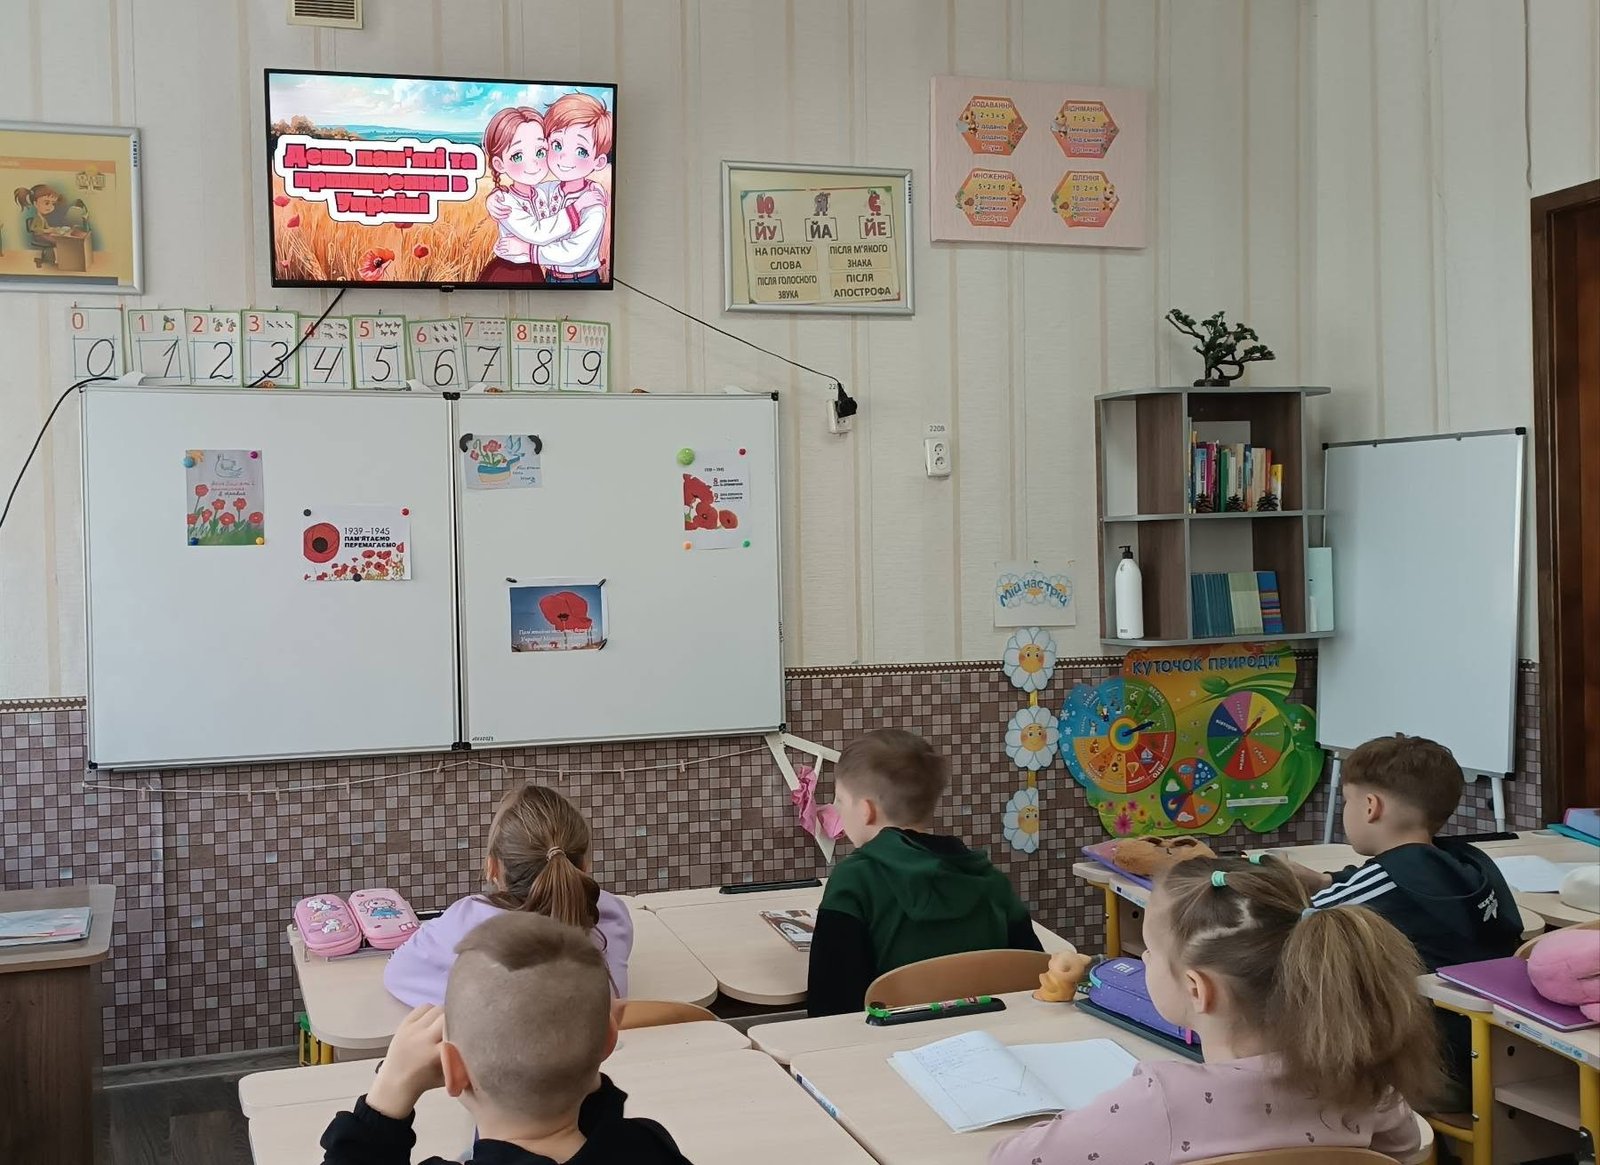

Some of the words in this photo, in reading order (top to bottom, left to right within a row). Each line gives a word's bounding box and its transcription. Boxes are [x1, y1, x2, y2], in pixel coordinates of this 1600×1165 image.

[283, 144, 353, 168] День
[293, 171, 449, 194] примирення
[334, 192, 430, 216] Україні
[755, 247, 768, 256] НА
[770, 246, 812, 255] ПОЧАТКУ
[830, 245, 851, 254] ПІСЛЯ
[770, 261, 802, 270] СЛОВА
[847, 259, 872, 268] ЗНАКА
[757, 276, 777, 285] ПІСЛЯ
[778, 275, 817, 285] ГОЛОСНОГО
[846, 274, 874, 283] ПІСЛЯ
[778, 290, 799, 299] ЗВУКА
[834, 286, 891, 297] АПОСТРОФА
[72, 312, 84, 330] 0
[138, 314, 146, 331] 1
[192, 316, 203, 333] 2
[249, 316, 260, 332] 3
[359, 321, 370, 338] 5
[464, 322, 474, 337] 7
[416, 326, 427, 343] 6
[516, 324, 527, 340] 8
[567, 325, 578, 341] 9
[86, 338, 115, 377] 0
[163, 338, 179, 378] 1
[209, 341, 233, 379] 2
[262, 341, 288, 378] 3
[313, 347, 343, 383] 4
[371, 346, 398, 381] 5
[477, 346, 500, 382] 7
[433, 349, 454, 386] 6
[532, 349, 553, 385] 8
[577, 351, 602, 385] 9
[1000, 582, 1022, 607] Мій
[1024, 579, 1067, 606] настрій
[1132, 658, 1202, 675] КУТОЧОК
[1208, 654, 1280, 670] ПРИРОДИ
